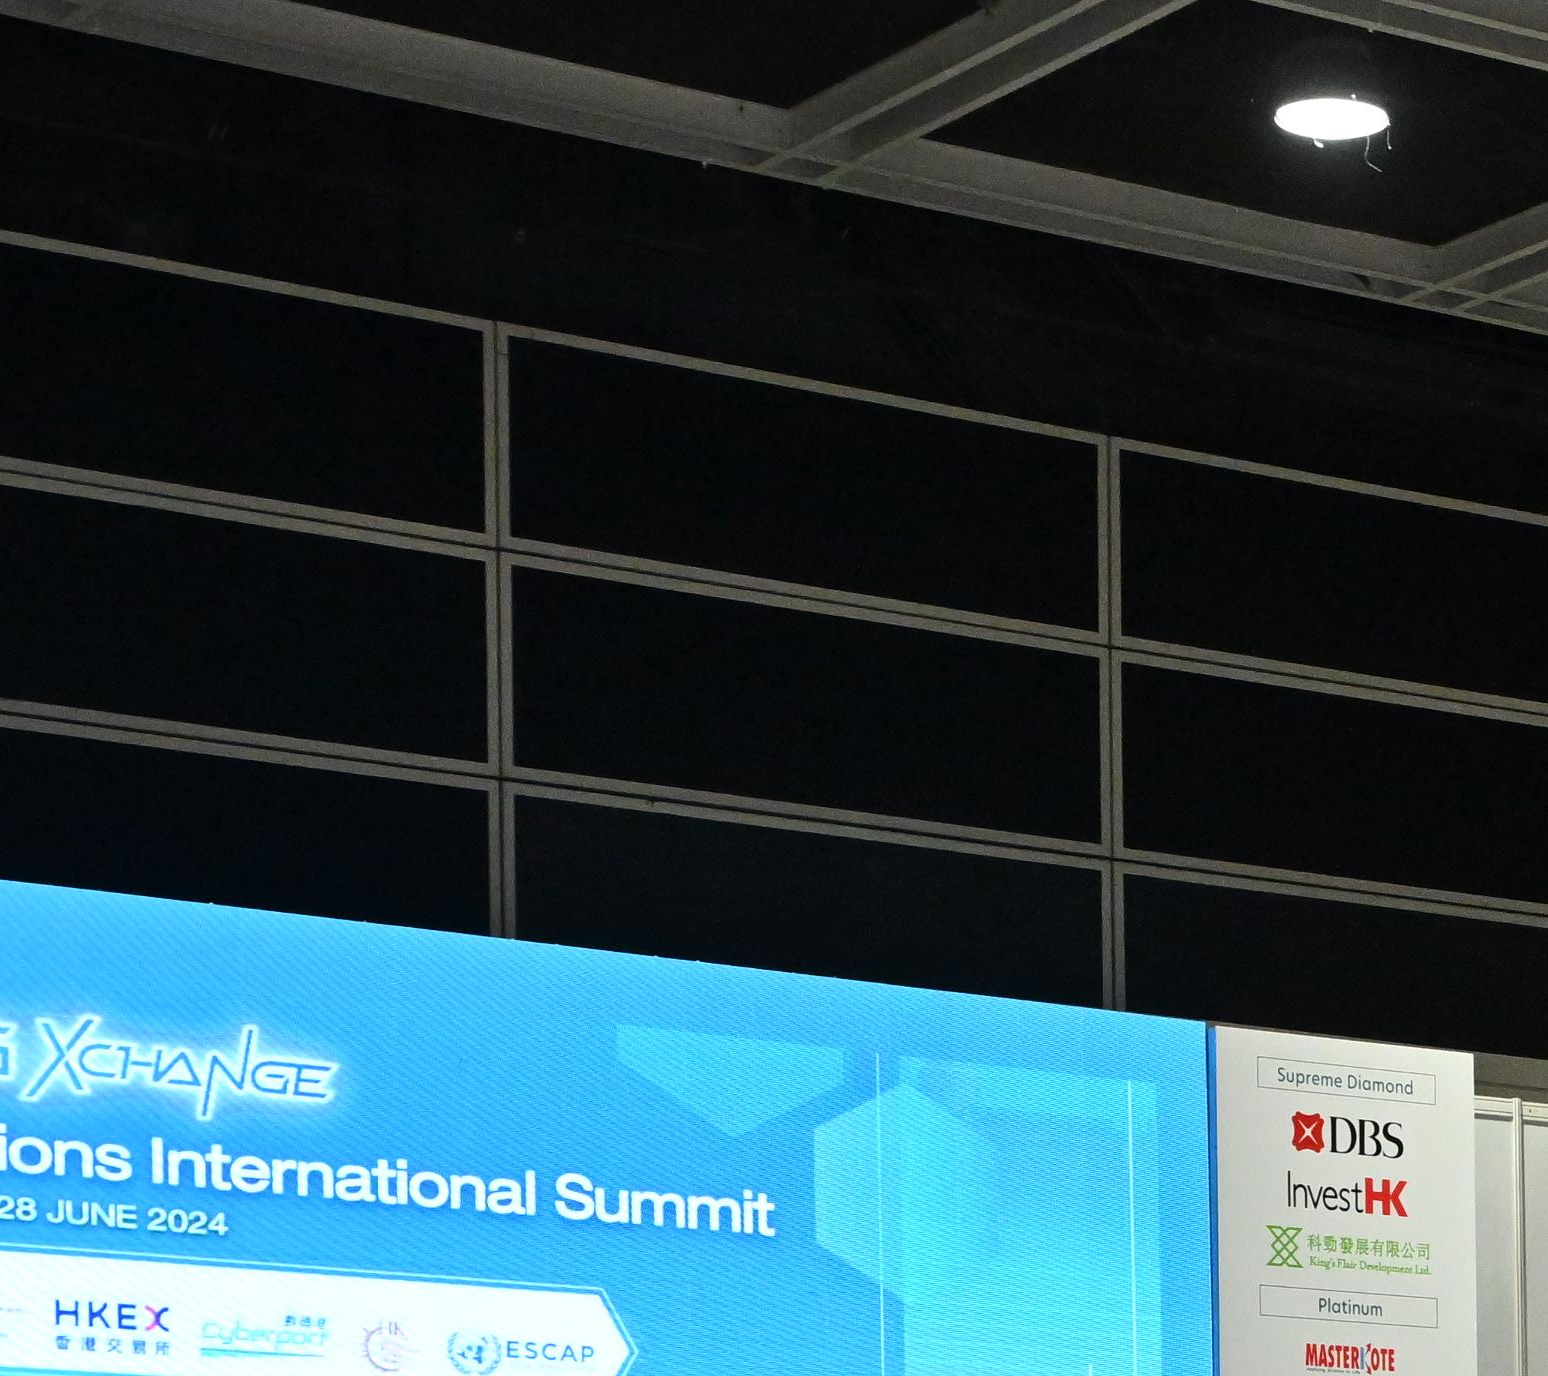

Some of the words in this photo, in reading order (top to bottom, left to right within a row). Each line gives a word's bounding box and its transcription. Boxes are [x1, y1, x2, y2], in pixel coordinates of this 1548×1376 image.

[1277, 1066, 1343, 1088] Supreme
[1347, 1074, 1414, 1096] Diamond
[1329, 1116, 1405, 1159] DBS
[150, 1136, 537, 1218] International
[554, 1172, 777, 1238] Summit
[1286, 1170, 1409, 1218] InvestHK
[45, 1198, 139, 1231] JUNE
[146, 1206, 230, 1238] 2024
[1309, 1255, 1337, 1271] King's
[1337, 1258, 1357, 1270] Flair
[1359, 1260, 1414, 1275] Development
[54, 1298, 171, 1333] HKEX
[1318, 1297, 1384, 1317] Platinum
[504, 1339, 595, 1364] ESCAP
[1305, 1343, 1396, 1375] MASTERKOTE
